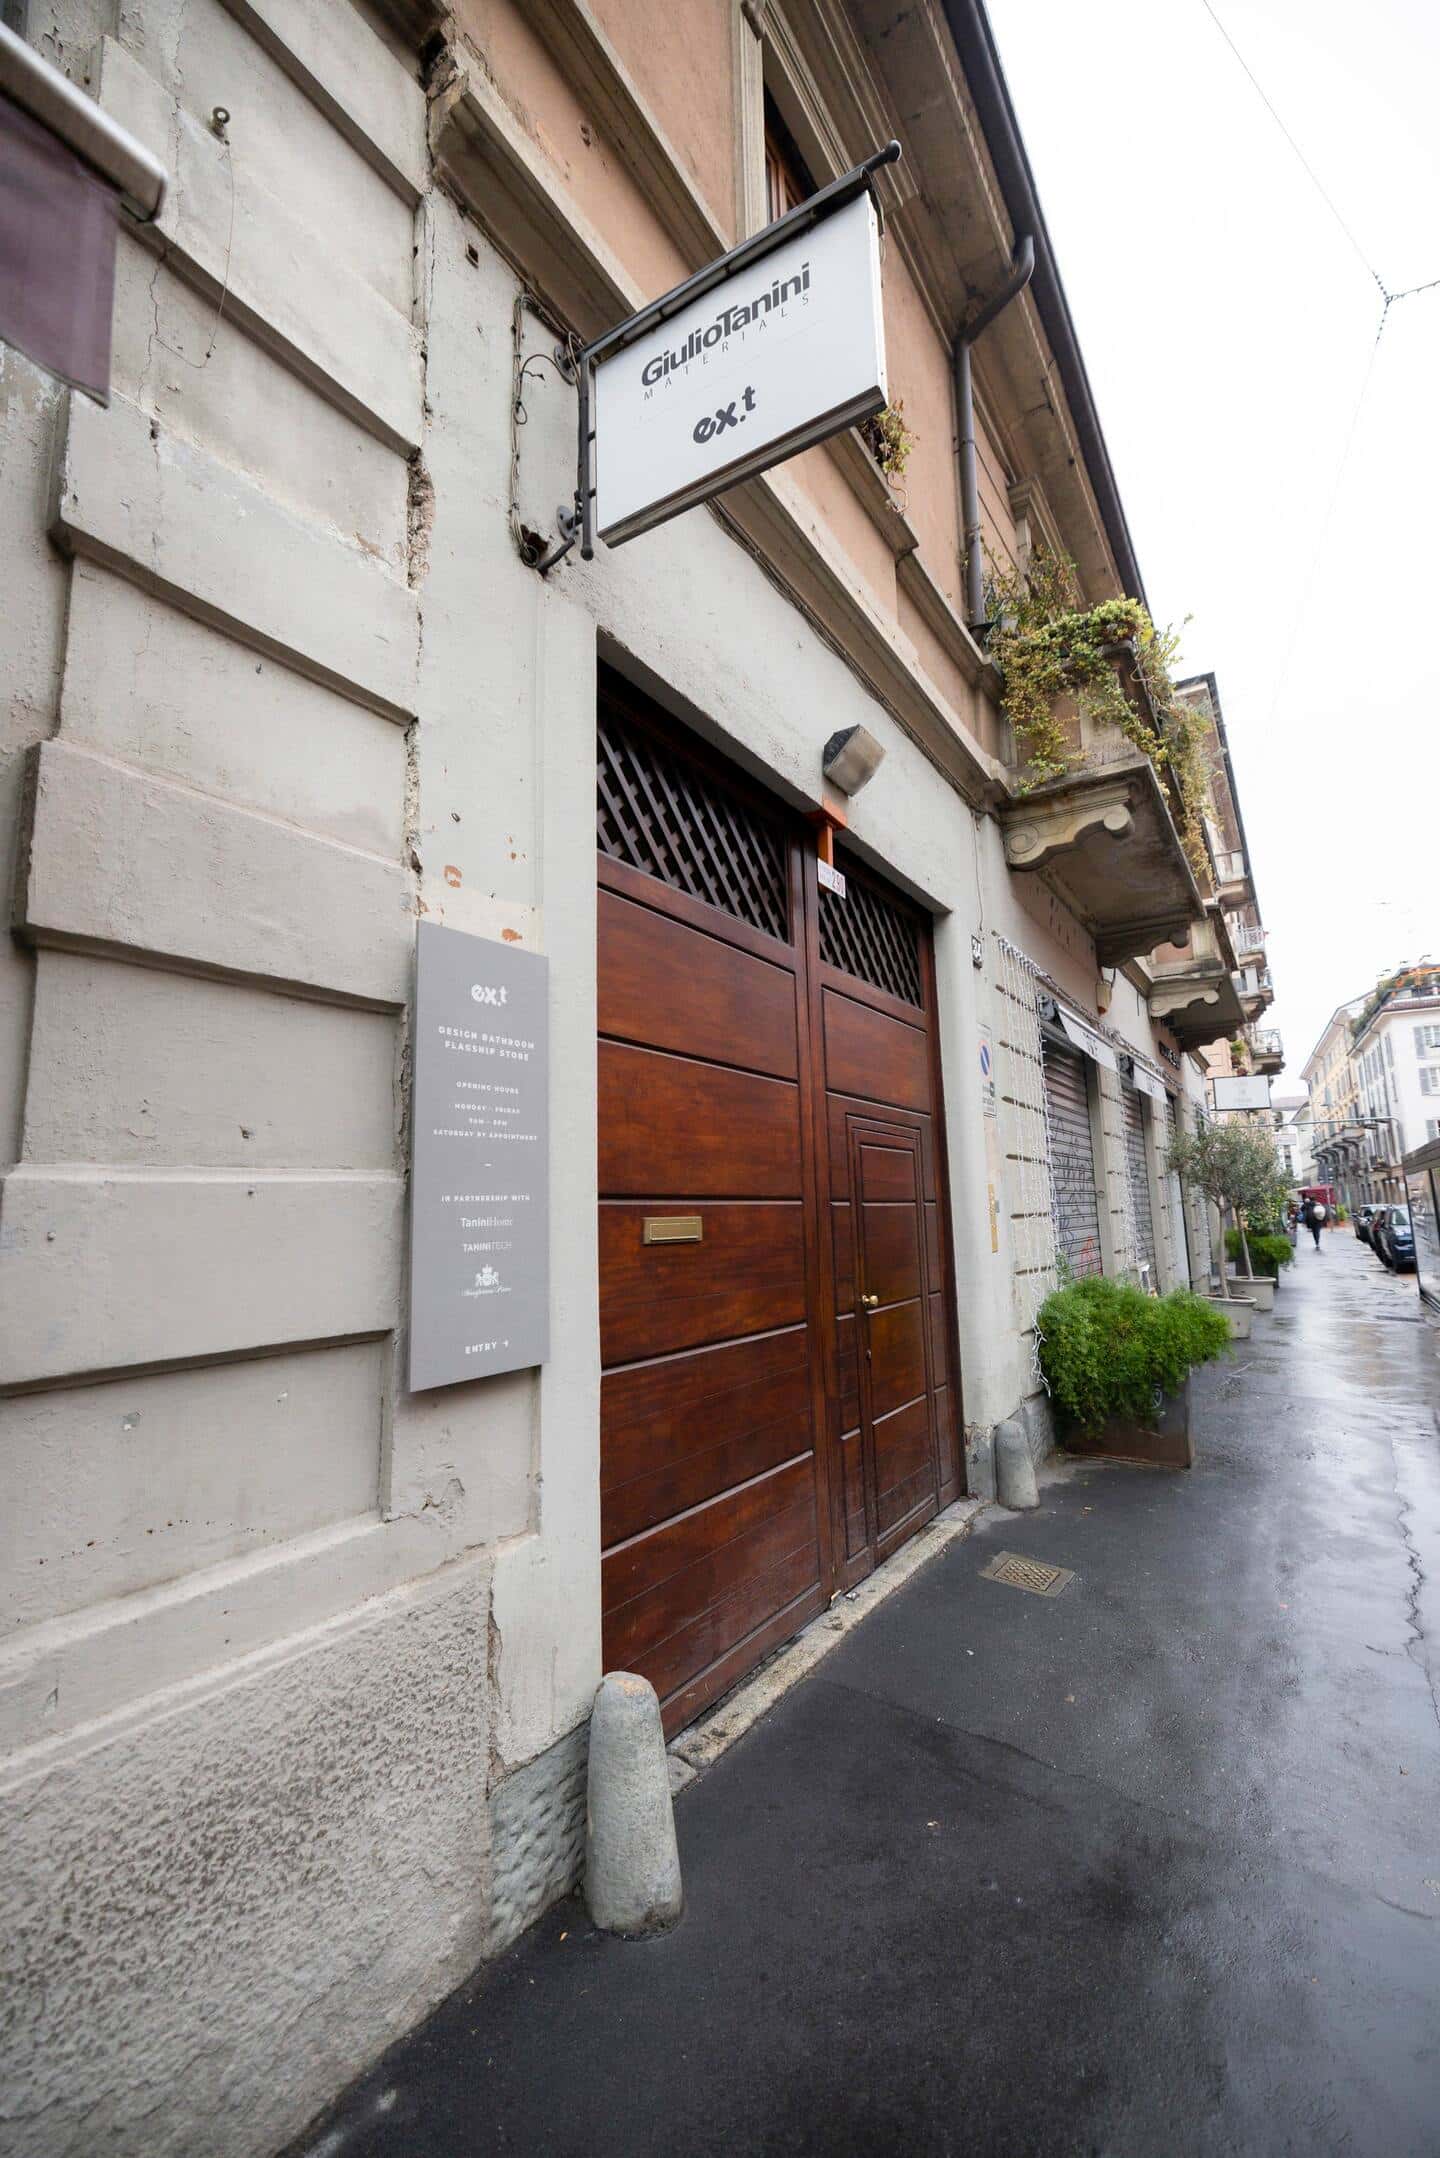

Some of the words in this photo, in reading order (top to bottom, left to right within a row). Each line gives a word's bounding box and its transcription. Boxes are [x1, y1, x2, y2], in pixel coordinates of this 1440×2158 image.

[641, 262, 810, 387] GiulioTanini
[643, 295, 809, 401] MATERIALS
[693, 386, 757, 444] ex.t
[471, 984, 507, 1007] ex.t
[438, 1025, 477, 1040] DESIGN
[482, 1033, 534, 1049] BATHROOM
[445, 1040, 496, 1054] FLAGSHIP
[499, 1049, 529, 1061] STORE
[456, 1081, 491, 1091] OPENING
[494, 1086, 519, 1095] HOURS
[454, 1103, 486, 1111] MONDAY
[433, 1128, 473, 1137] SATURDAY
[489, 1132, 537, 1141] APPOINTMENT
[454, 1194, 508, 1202] PARTNERSHIP
[465, 1341, 497, 1354] ENTRY
